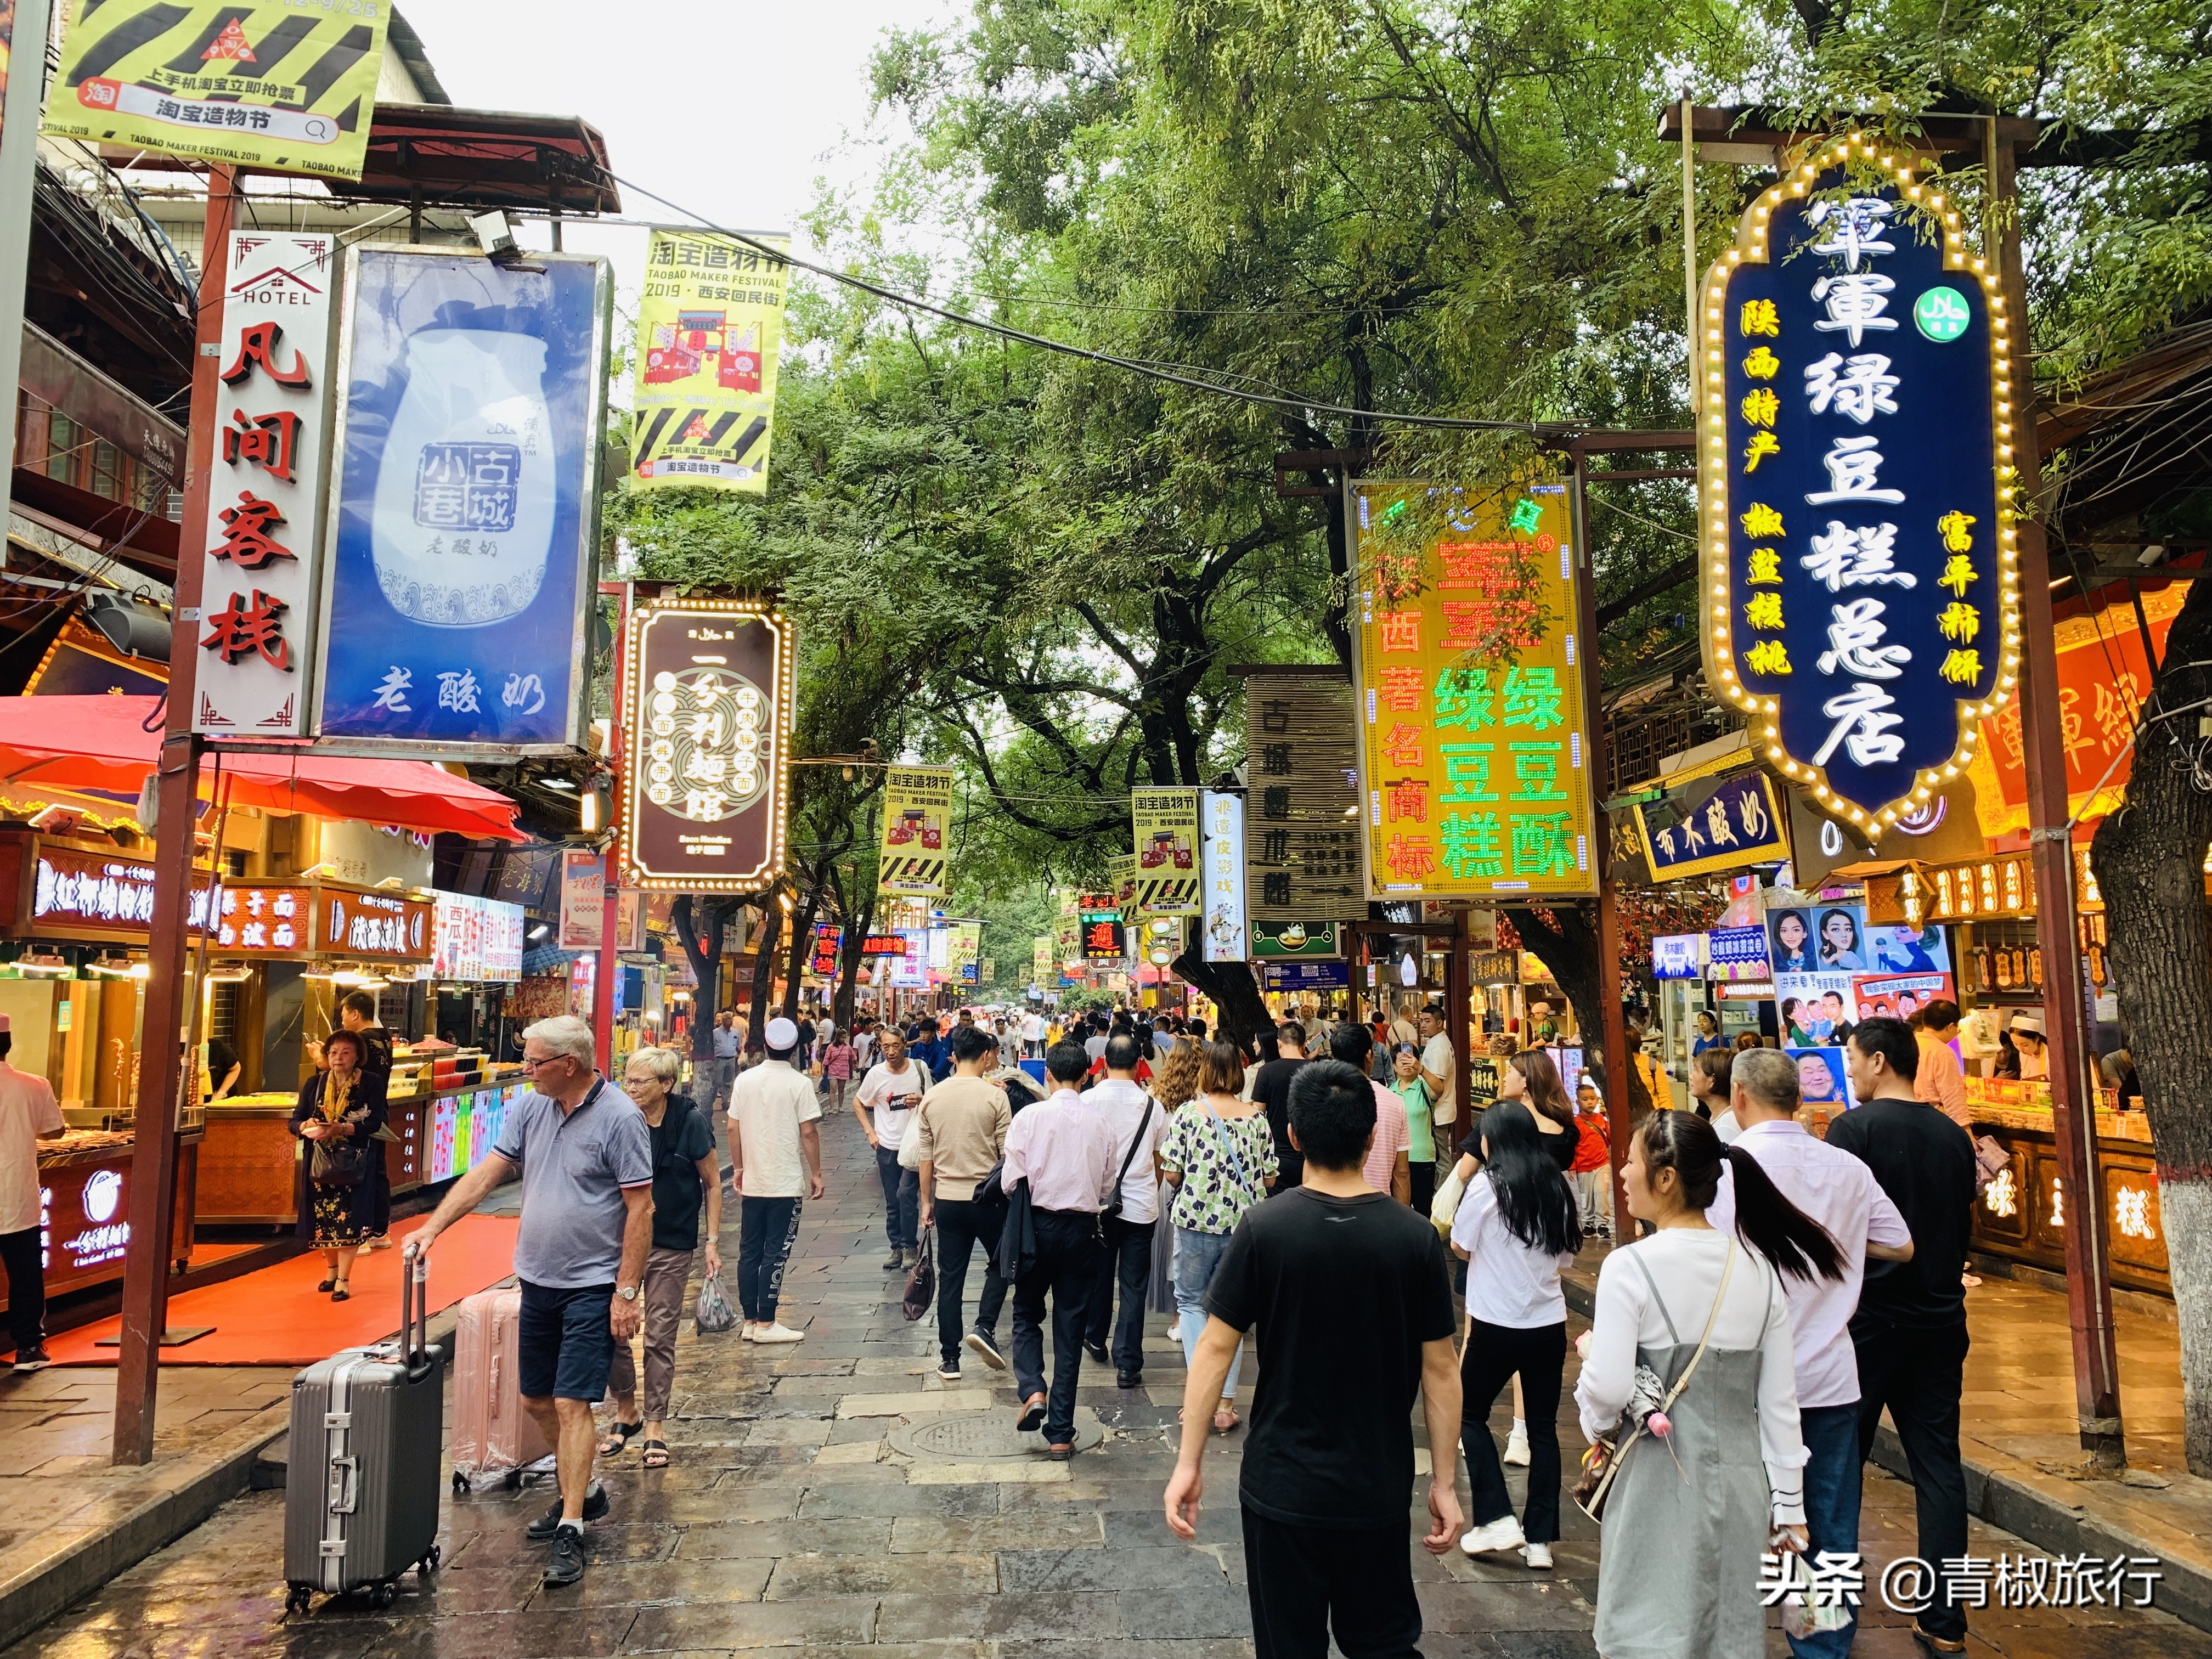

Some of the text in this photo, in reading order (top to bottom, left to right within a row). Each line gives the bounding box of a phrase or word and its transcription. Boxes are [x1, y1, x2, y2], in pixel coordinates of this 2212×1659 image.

[85, 83, 115, 104] 淘
[145, 69, 296, 100] 上手机淘宝立即抢票
[156, 99, 271, 129] 淘宝造物节
[70, 126, 89, 136] 2019
[130, 134, 261, 161] TAOBAO MAKER FESTIVAL 2019
[301, 160, 334, 172] TAOBAO
[648, 269, 781, 288] TAOBAO MAKER FESTIVAL
[244, 290, 312, 306] HOTEL
[646, 283, 779, 307] 2019 西安回民街
[1740, 297, 1780, 476] 陕西特产
[661, 447, 731, 458] 上手机淘宝立即抢票
[667, 462, 720, 474] 淘宝造物节
[200, 321, 313, 673] 凡间客栈
[426, 535, 498, 558] 老酸奶
[1741, 501, 1795, 678] 椒盐核桃
[1937, 509, 1984, 688] 富平柿饼
[371, 665, 546, 717] 老酸奶
[889, 773, 950, 789] 淘宝造物节
[1434, 667, 1504, 879] 绿豆糕
[1503, 666, 1576, 878] 绿豆酥
[912, 797, 948, 806] 西安回民街
[1135, 796, 1194, 810] 淘宝造物节
[1215, 799, 1233, 894] 非遗皮影戏
[904, 941, 918, 974] 皮影戏
[1264, 966, 1282, 977] 招聘
[1865, 978, 1941, 994] 我会实现大家的中国梦
